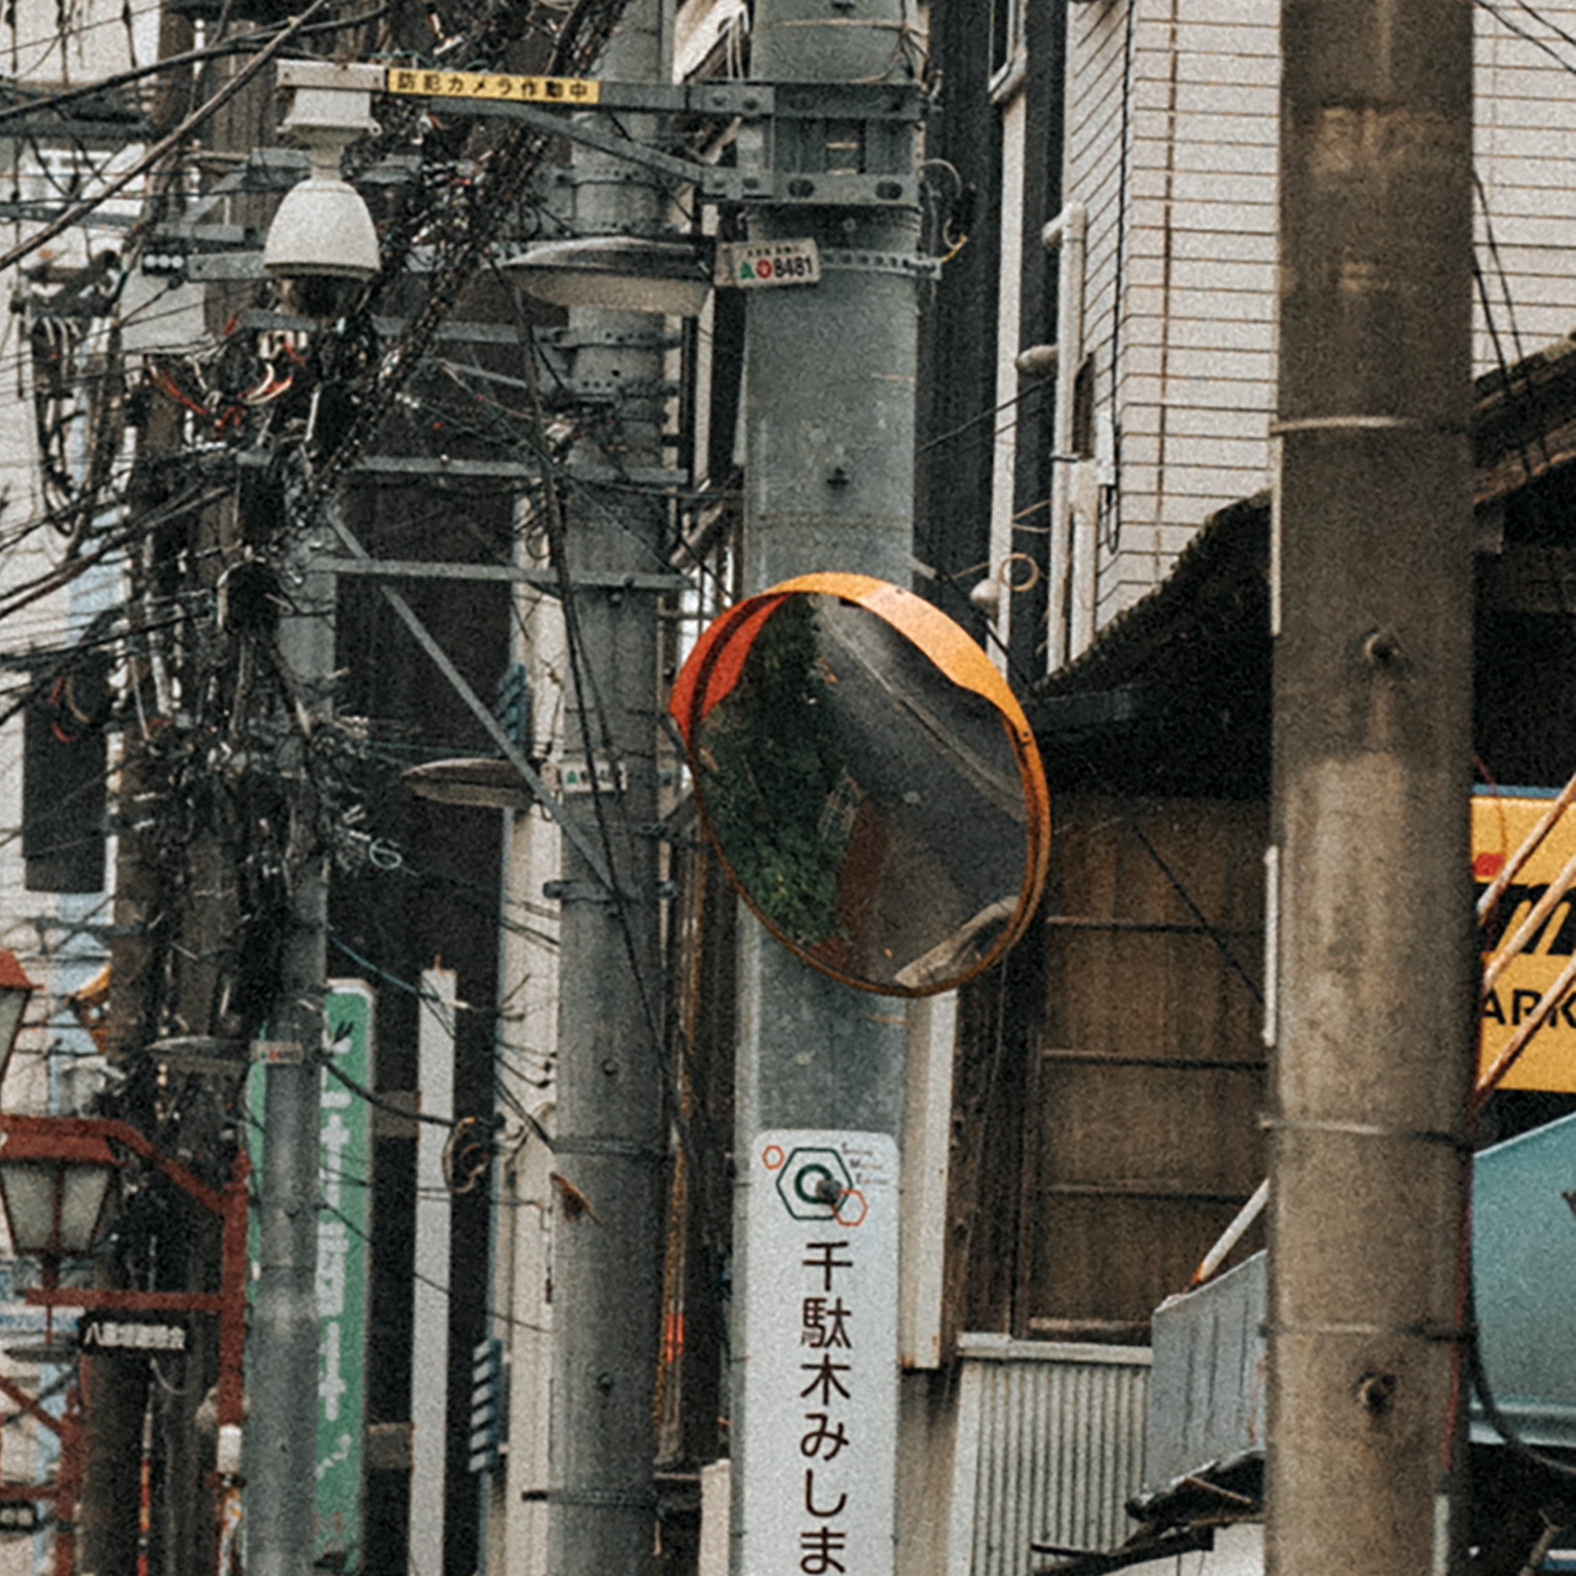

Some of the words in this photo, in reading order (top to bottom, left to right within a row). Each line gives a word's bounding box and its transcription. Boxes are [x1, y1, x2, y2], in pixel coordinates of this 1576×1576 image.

[397, 71, 588, 99] 防犯カメラ作動中
[774, 256, 813, 278] 8481
